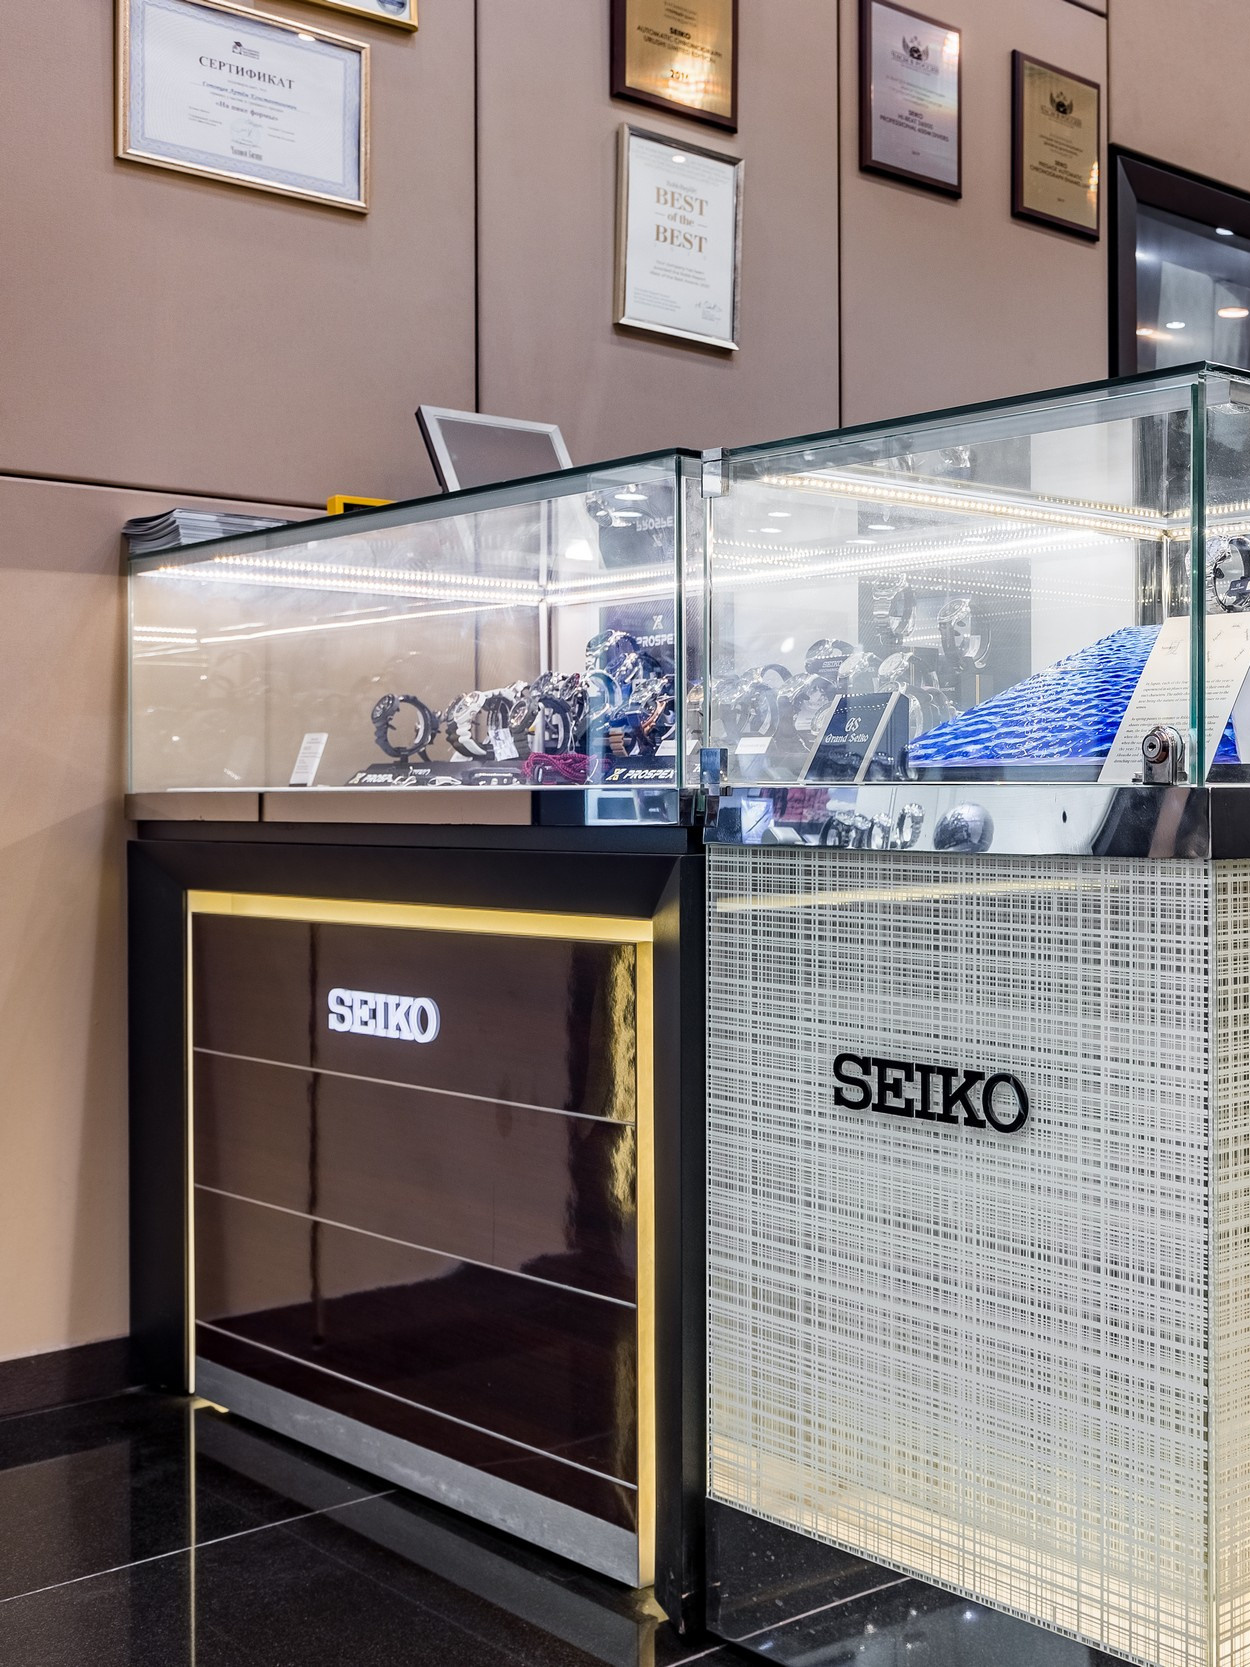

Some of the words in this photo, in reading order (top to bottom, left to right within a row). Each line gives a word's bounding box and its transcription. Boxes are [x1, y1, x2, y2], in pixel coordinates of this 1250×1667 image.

[669, 27, 692, 40] SEIKO
[199, 55, 295, 90] СЕРТИФИКАТ
[655, 186, 709, 216] BEST
[667, 212, 677, 222] of
[679, 214, 694, 226] the
[655, 223, 708, 253] BEST
[636, 633, 675, 648] PROSPE
[845, 717, 862, 732] GS
[825, 733, 848, 743] Grand
[849, 733, 869, 742] Seiko
[623, 768, 677, 780] PROSPEX
[327, 987, 441, 1043] SEIKO
[833, 1052, 1029, 1133] SEIKO
